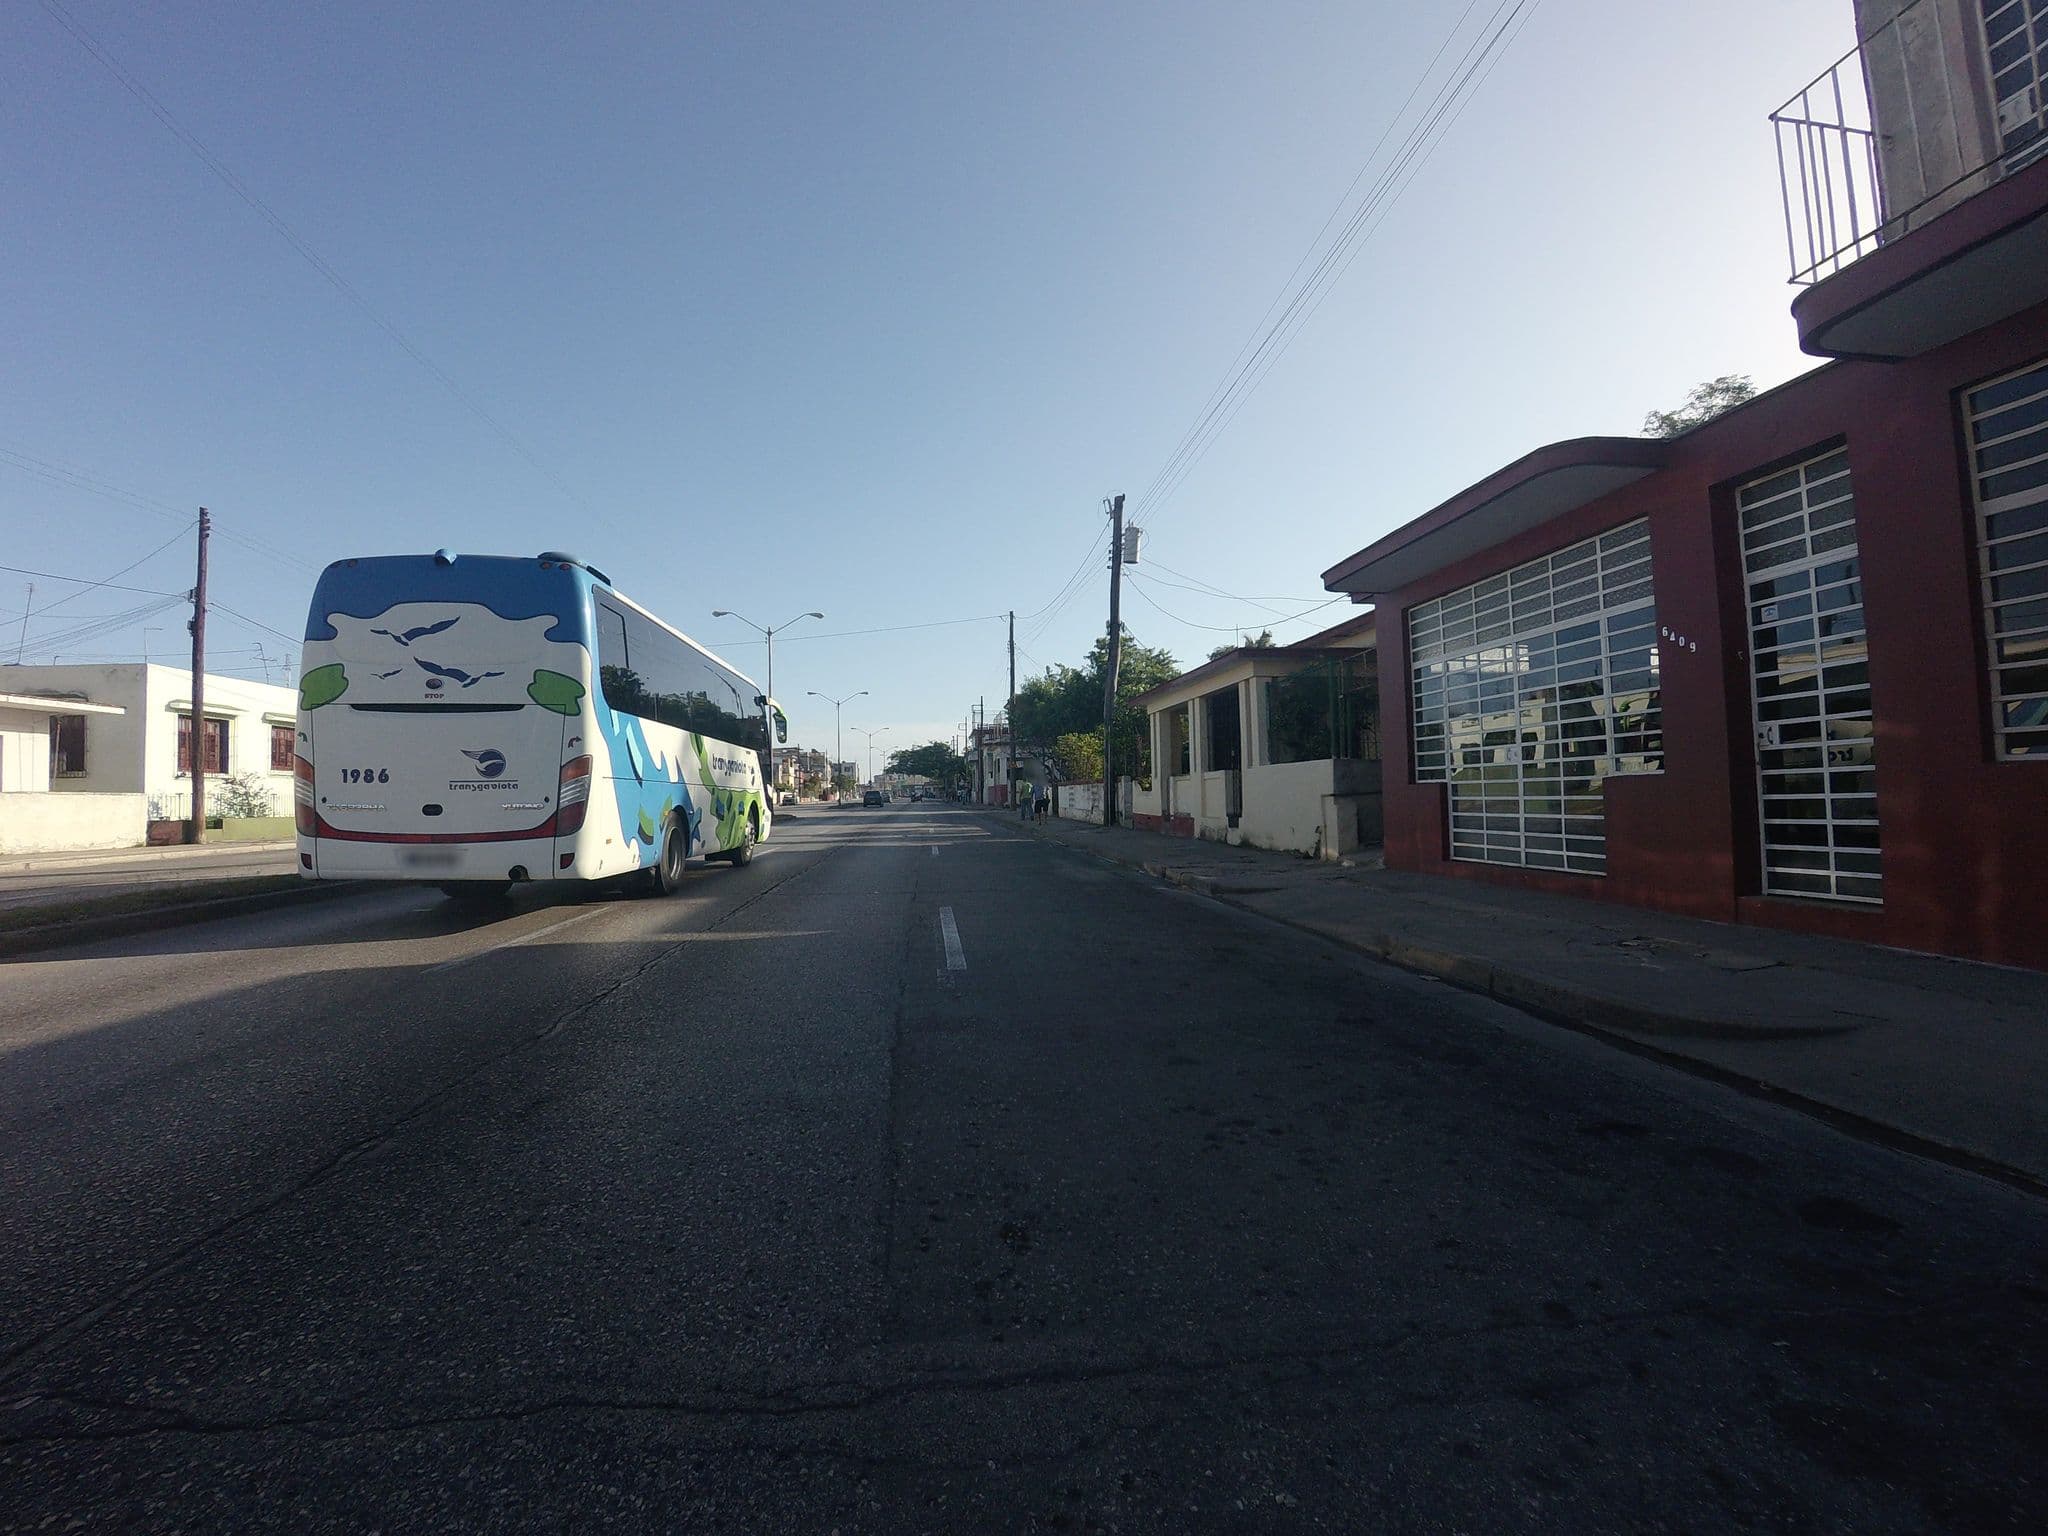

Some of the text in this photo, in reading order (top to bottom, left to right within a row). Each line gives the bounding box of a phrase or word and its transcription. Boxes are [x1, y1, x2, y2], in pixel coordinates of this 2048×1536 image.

[1662, 626, 1696, 653] 6409
[341, 768, 390, 784] 1986
[449, 782, 519, 792] transgaviota
